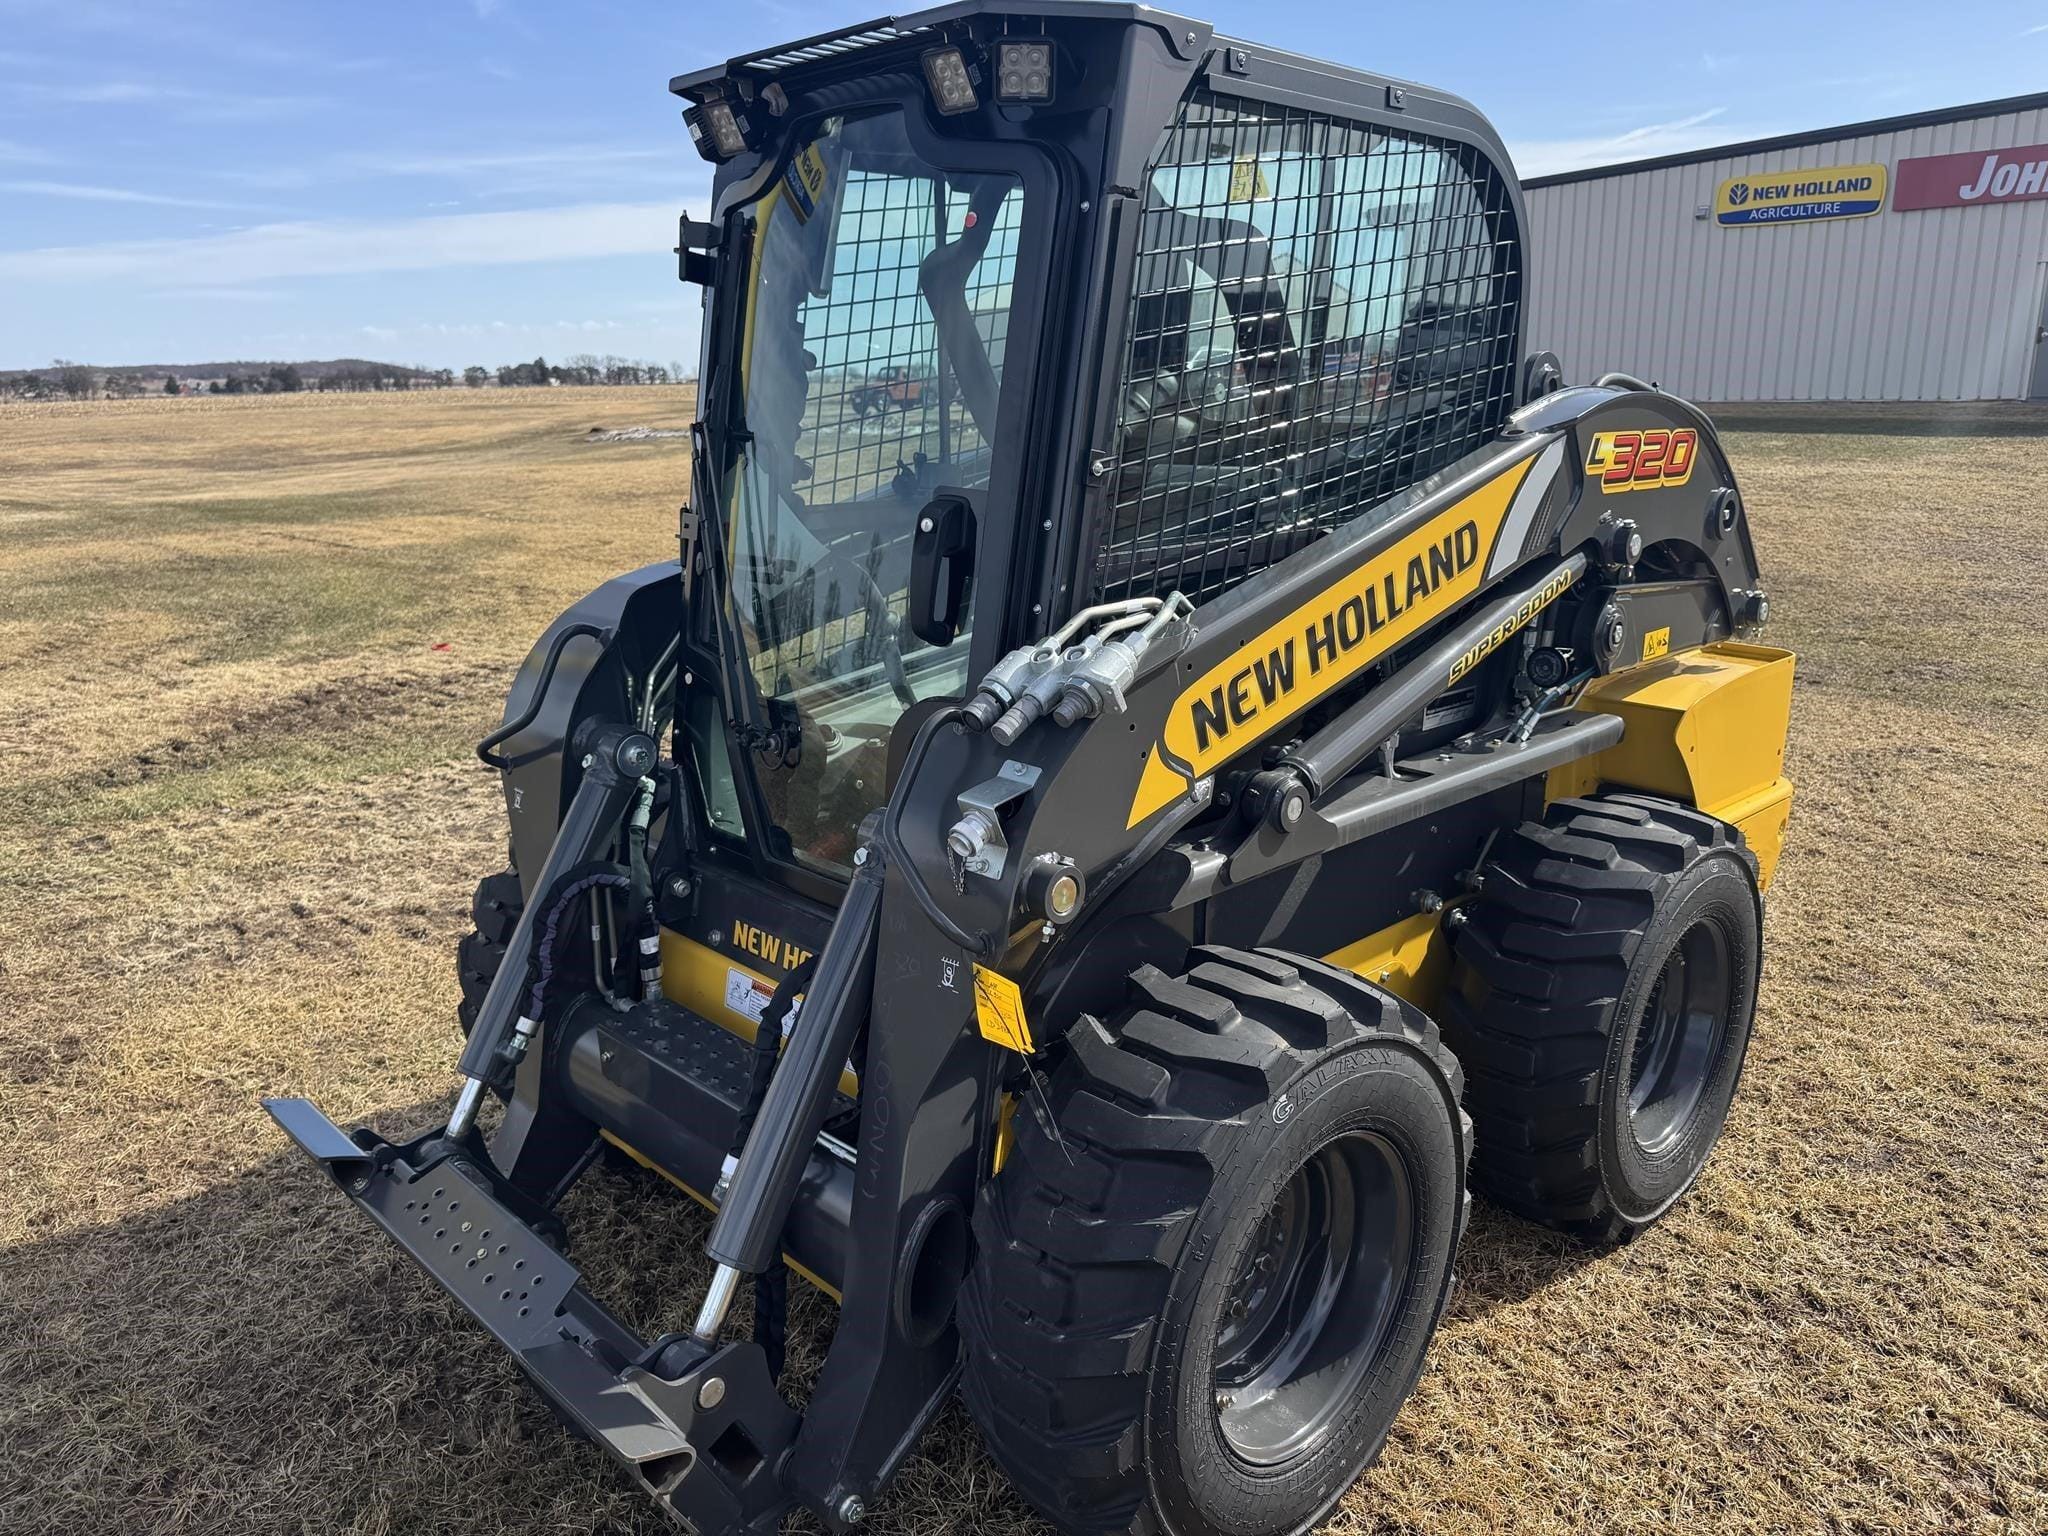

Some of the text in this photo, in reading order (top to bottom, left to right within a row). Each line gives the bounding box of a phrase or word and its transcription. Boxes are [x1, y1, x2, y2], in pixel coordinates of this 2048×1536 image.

[1752, 176, 1873, 201] NEW HOLLAND
[1960, 154, 2048, 200] JOH
[1749, 201, 1841, 220] AGRICULTURE
[1586, 428, 1698, 493] L320
[1189, 519, 1480, 755] NEW HOLLAND
[733, 919, 781, 964] NEW
[1272, 1048, 1399, 1124] GALAXY
